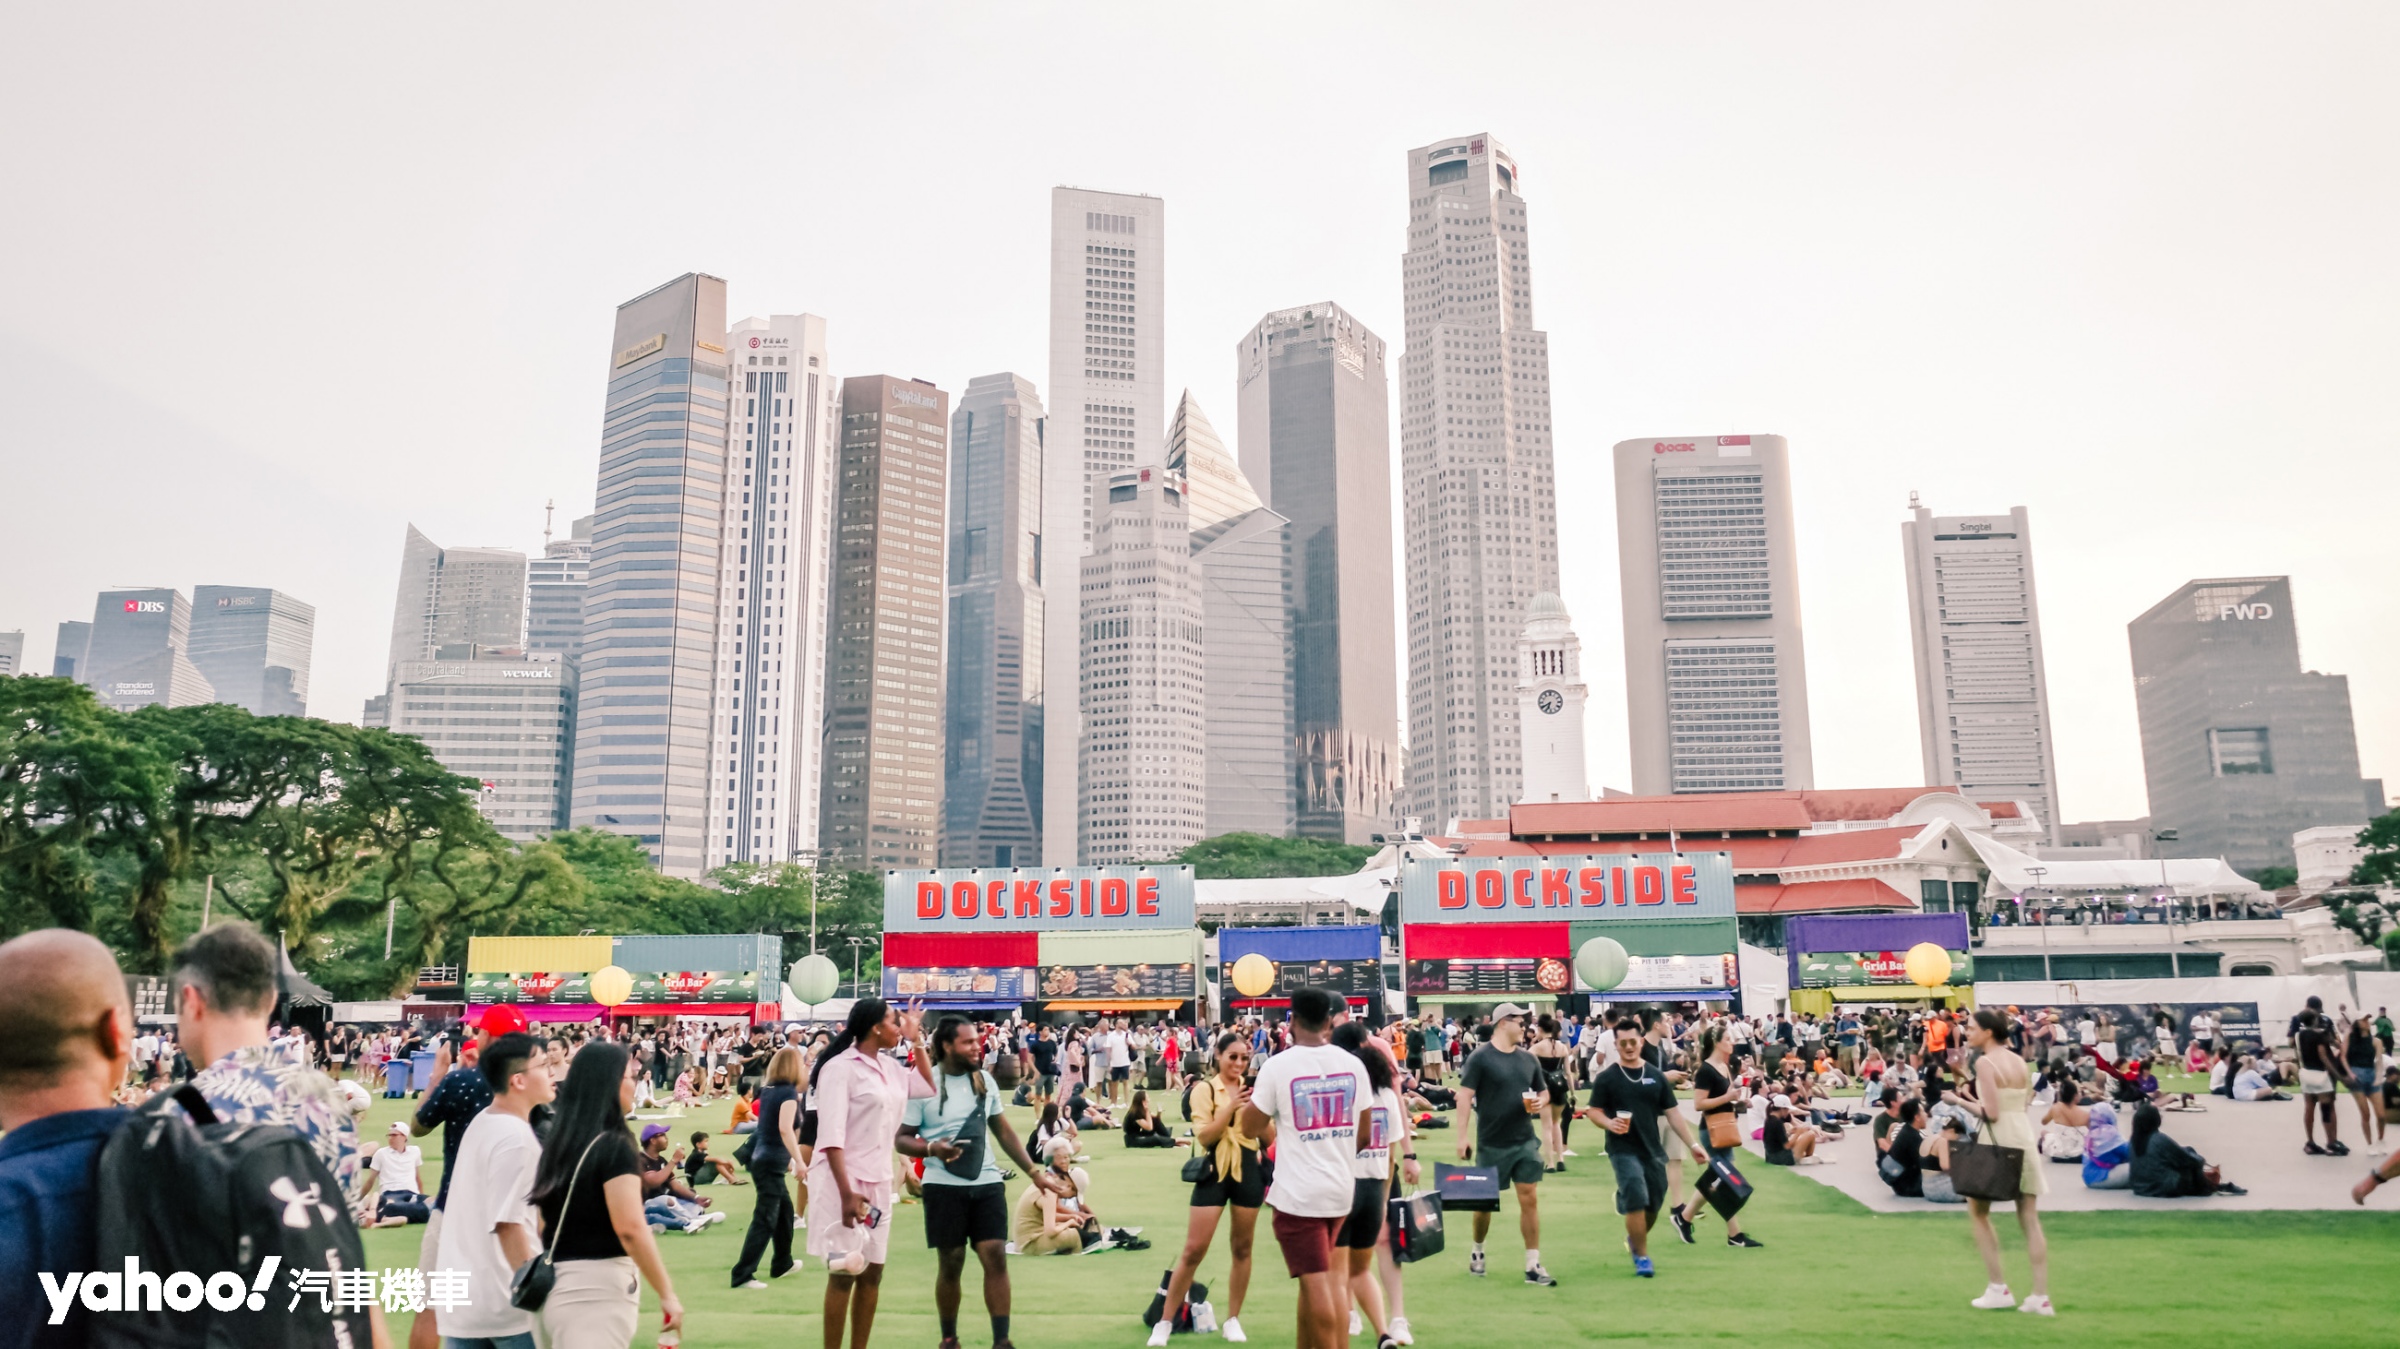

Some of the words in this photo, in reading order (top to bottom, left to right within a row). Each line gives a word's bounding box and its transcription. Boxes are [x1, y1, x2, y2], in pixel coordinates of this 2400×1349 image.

[624, 338, 659, 360] Maybank
[1960, 523, 1992, 533] Singtel
[137, 602, 165, 612] DBS
[231, 597, 256, 606] HSBC
[2220, 603, 2273, 621] FWD
[502, 666, 553, 678] wework
[1437, 865, 1697, 909] DOCKSIDE
[917, 877, 1160, 919] DOCKSIDE
[1862, 961, 1887, 971] Grid
[517, 979, 537, 988] Grid
[539, 979, 556, 988] Bar
[664, 978, 685, 987] Grid
[687, 978, 705, 987] Bar
[1300, 1078, 1350, 1091] SINGAPORE
